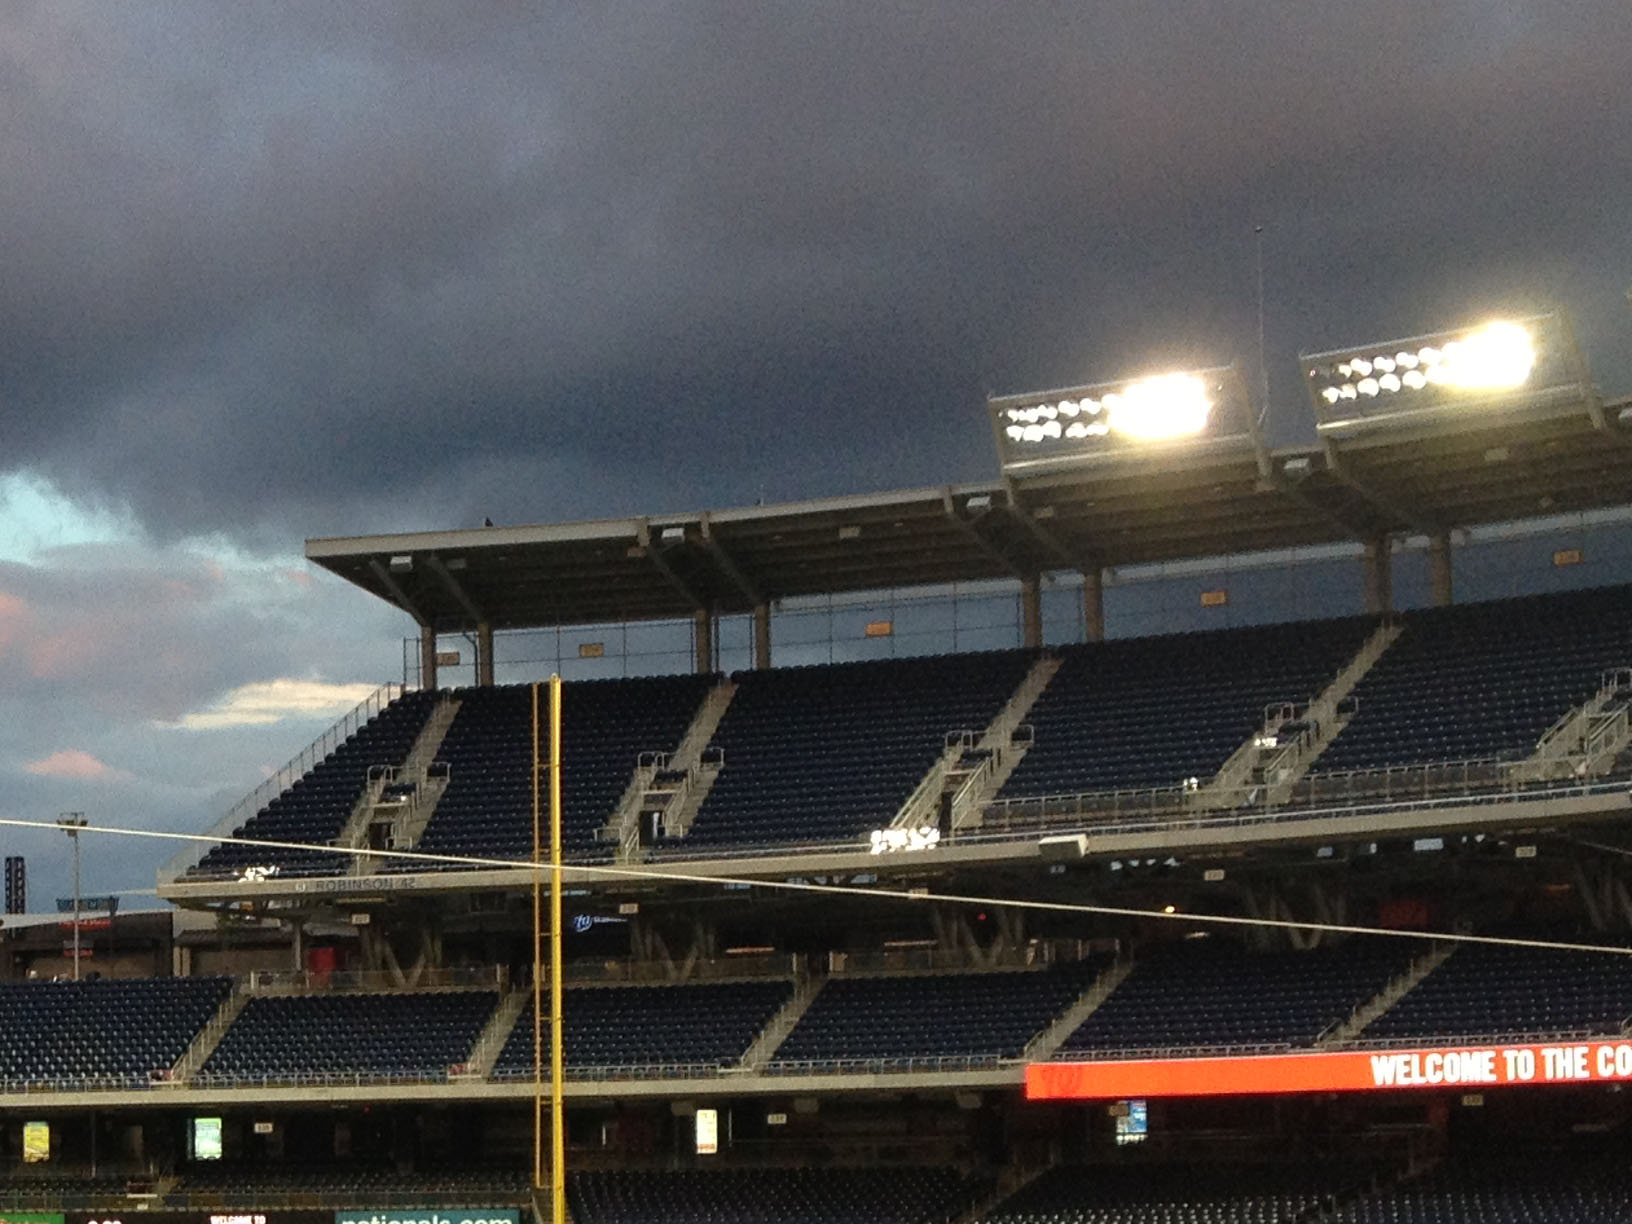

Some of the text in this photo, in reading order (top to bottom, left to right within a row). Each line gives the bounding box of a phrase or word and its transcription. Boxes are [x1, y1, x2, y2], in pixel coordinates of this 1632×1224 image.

[1371, 1051, 1496, 1087] WELCOME
[1503, 1050, 1534, 1081] TO
[1542, 1047, 1589, 1079] THE
